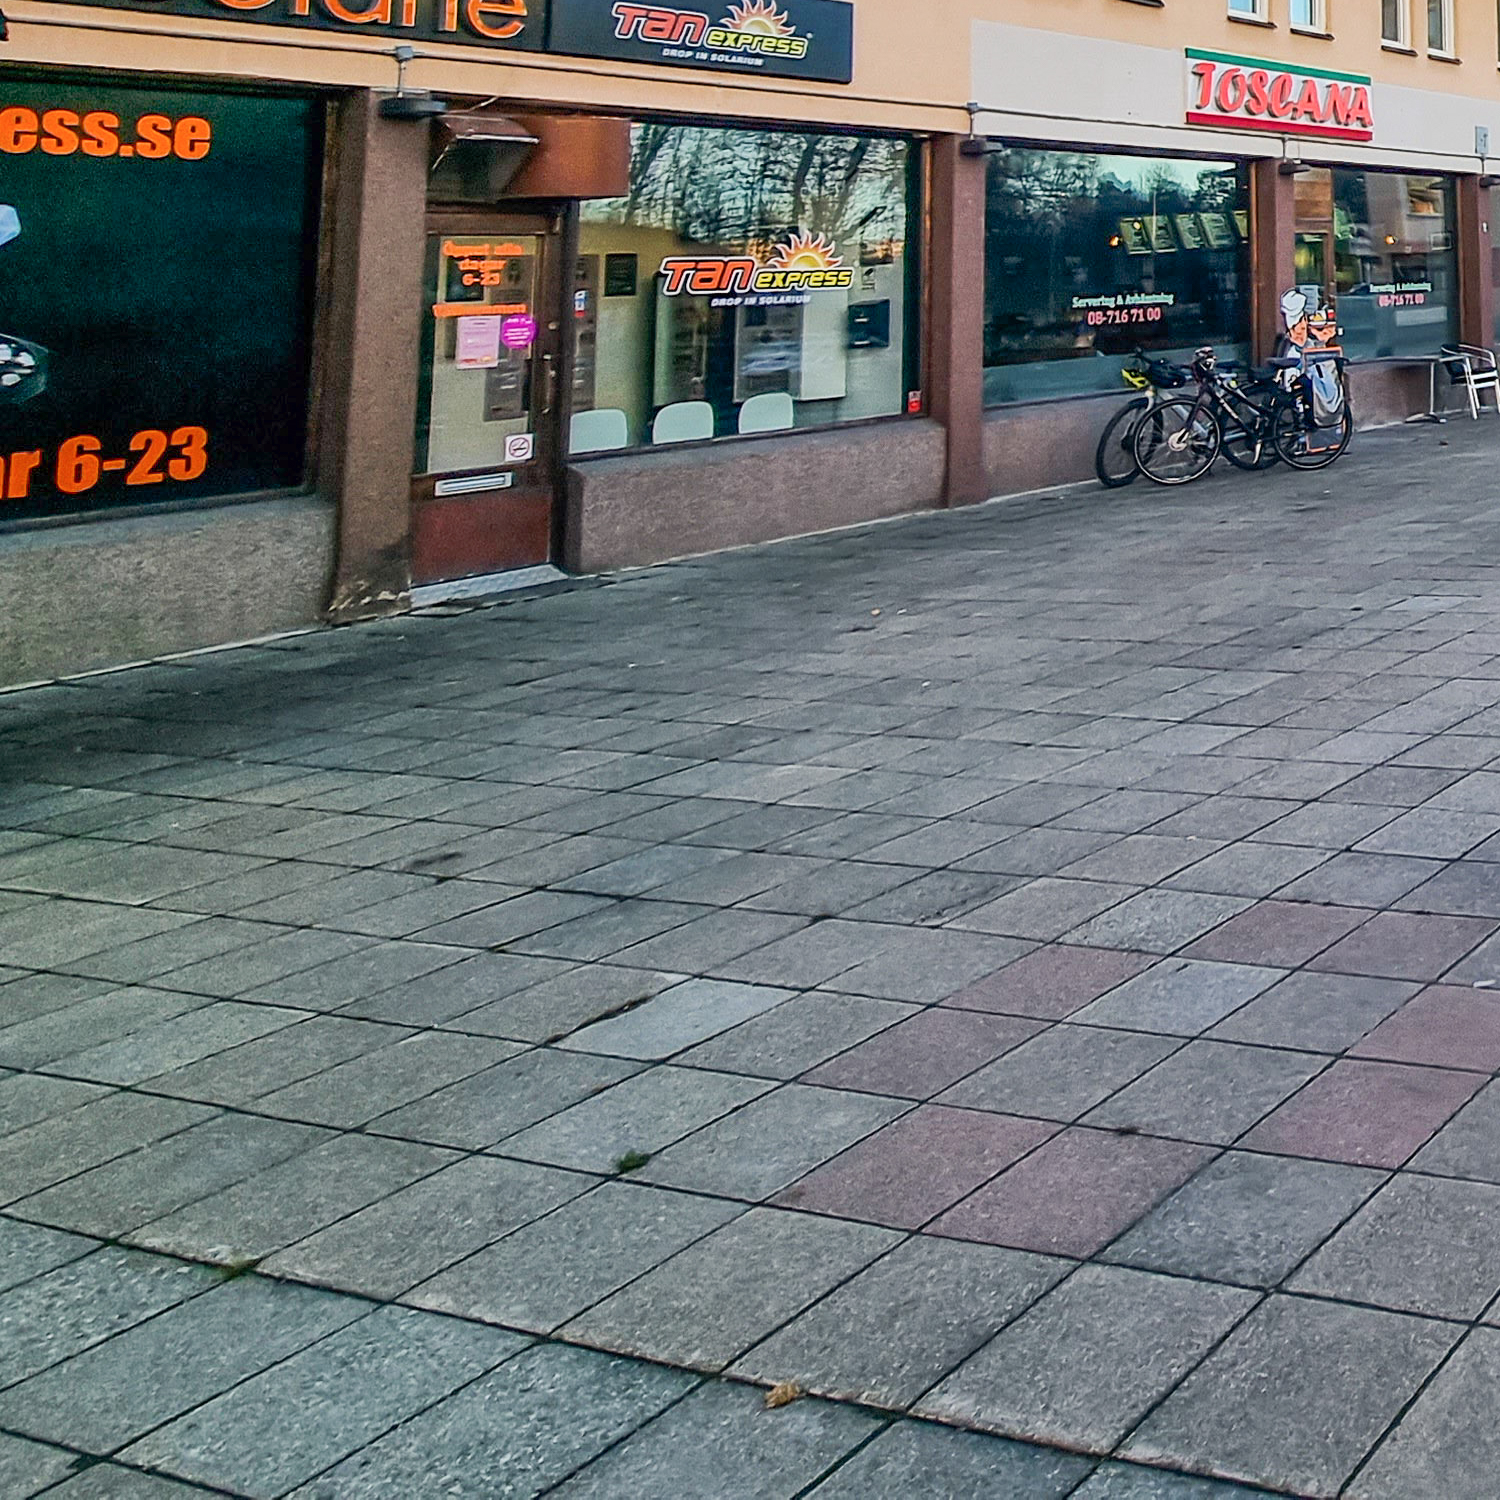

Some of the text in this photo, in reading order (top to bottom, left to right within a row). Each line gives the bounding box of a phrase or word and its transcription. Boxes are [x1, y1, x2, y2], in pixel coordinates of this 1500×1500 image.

[662, 47, 764, 67] DROP IN SOLARIUM
[1192, 62, 1374, 128] TOSCANA
[711, 294, 811, 307] DROP IN SOLARIUM
[1087, 307, 1161, 325] 08-716 71 00
[56, 426, 208, 494] 6-23
